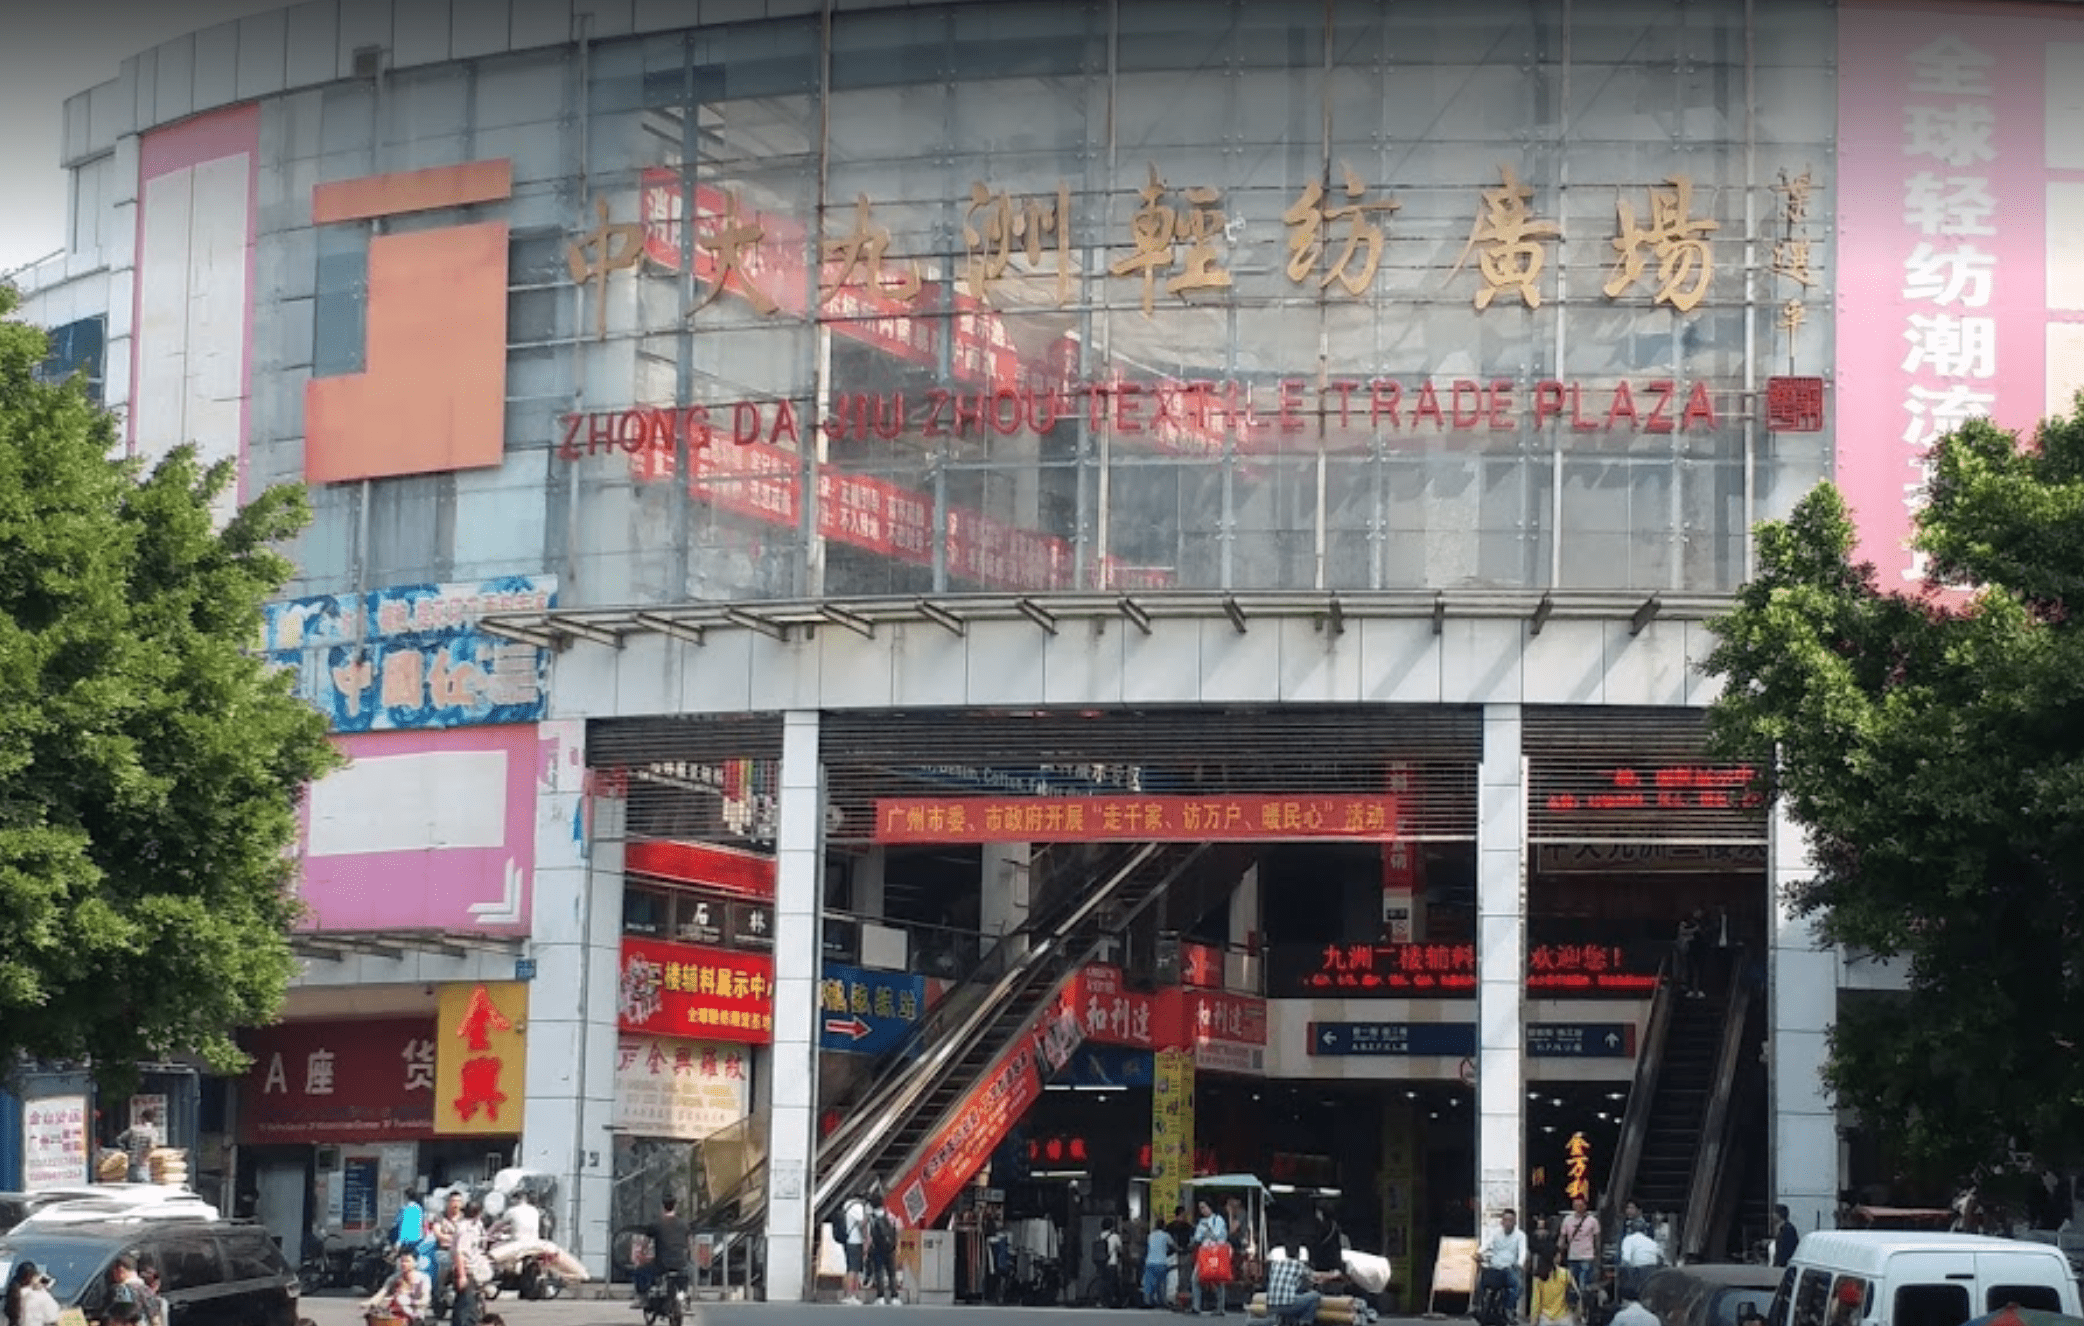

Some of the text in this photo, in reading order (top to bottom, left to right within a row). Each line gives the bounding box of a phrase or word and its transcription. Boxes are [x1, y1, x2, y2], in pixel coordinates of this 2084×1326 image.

[556, 405, 711, 461] ZHONG
[733, 400, 799, 447] DA
[823, 392, 904, 441] JIU
[922, 388, 1057, 438] ZHOU
[1085, 377, 1306, 434] TEXTILE
[1332, 377, 1517, 432] TRADE
[1535, 377, 1719, 434] PLAZA
